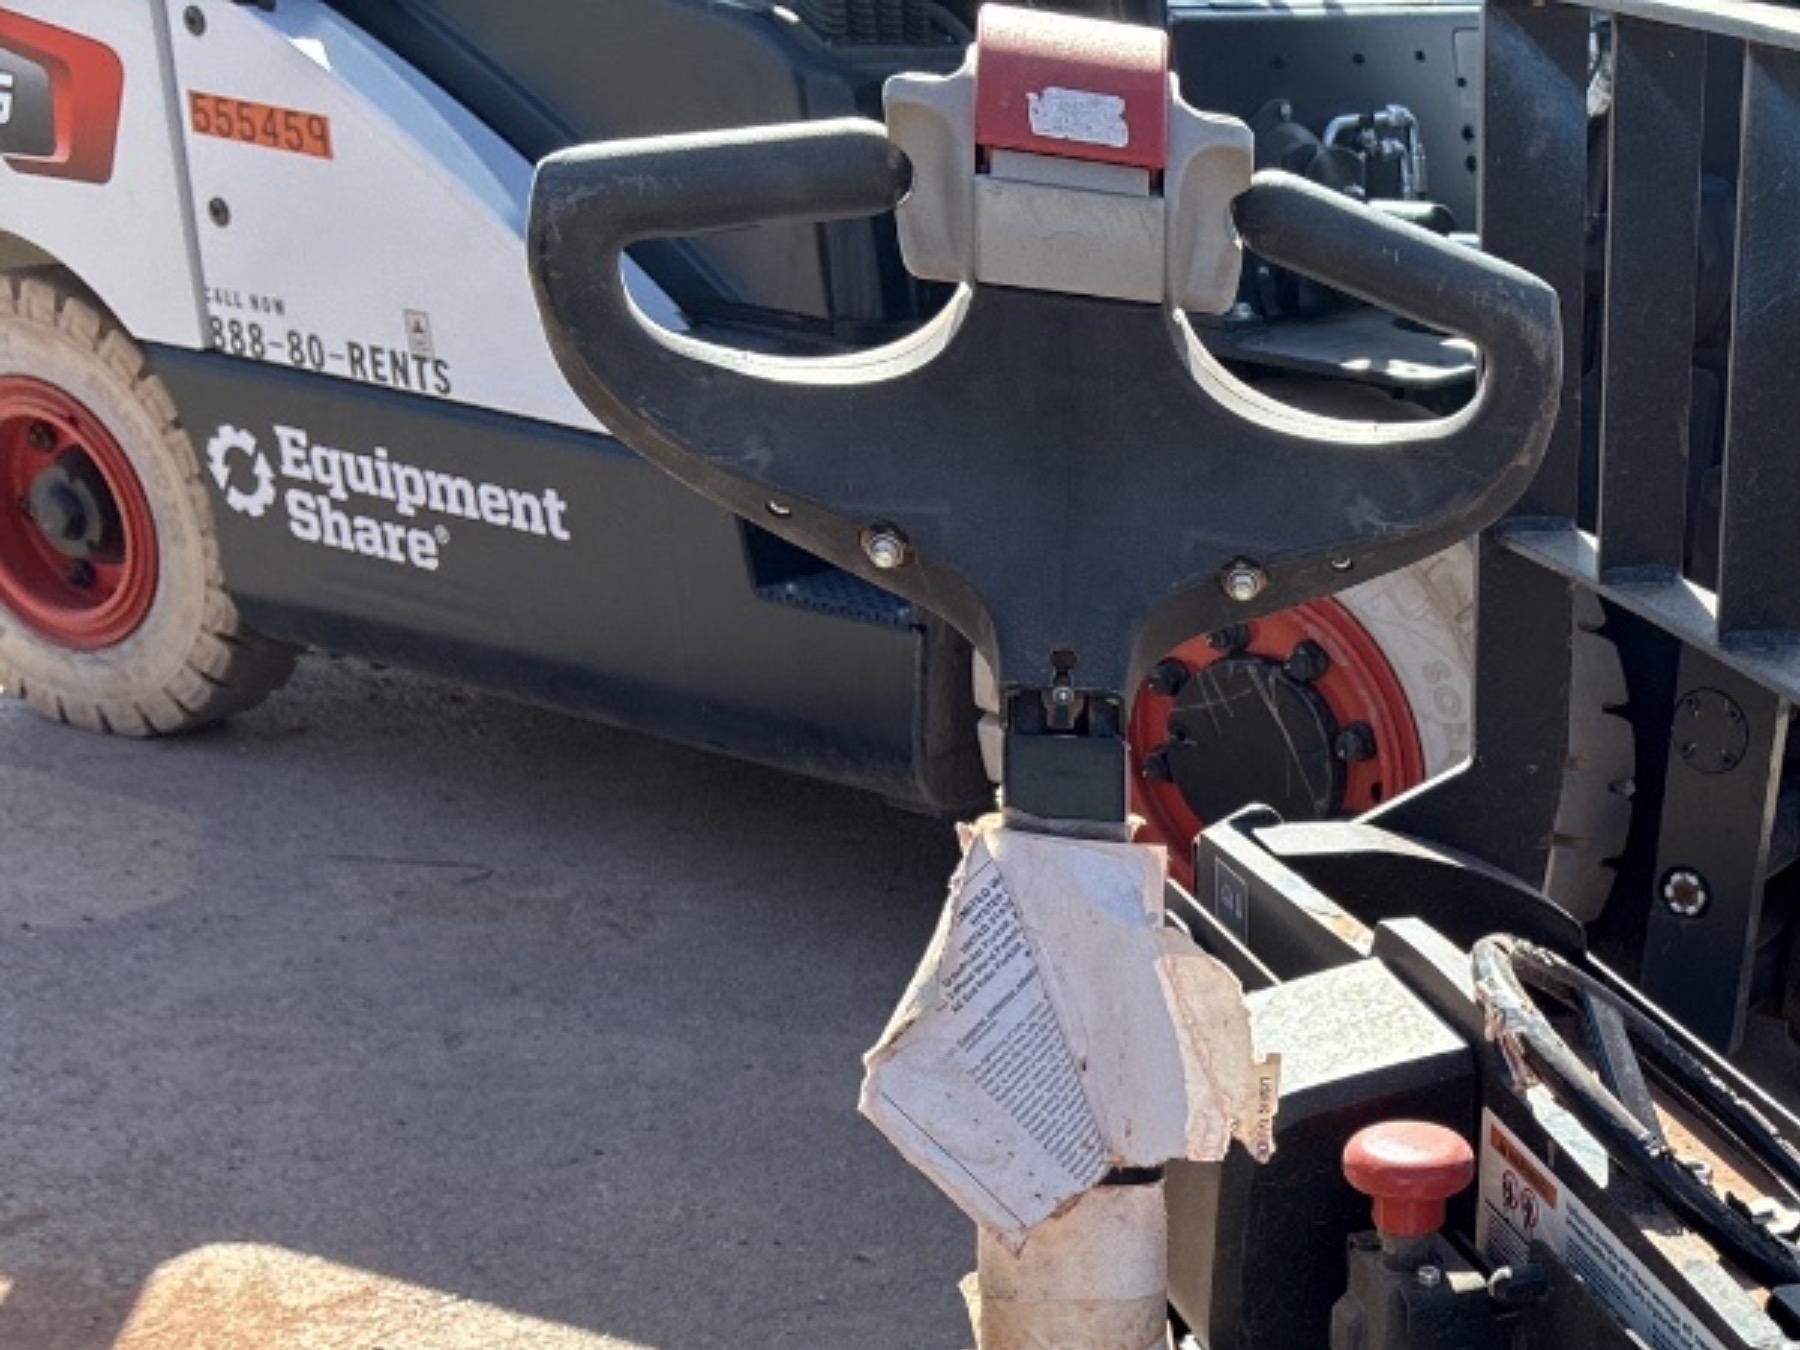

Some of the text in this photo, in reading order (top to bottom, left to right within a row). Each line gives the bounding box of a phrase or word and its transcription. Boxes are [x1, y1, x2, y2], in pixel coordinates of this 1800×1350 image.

[190, 94, 330, 157] 555459
[208, 315, 451, 395] 888-80-RENTS
[273, 424, 571, 540] Equipment
